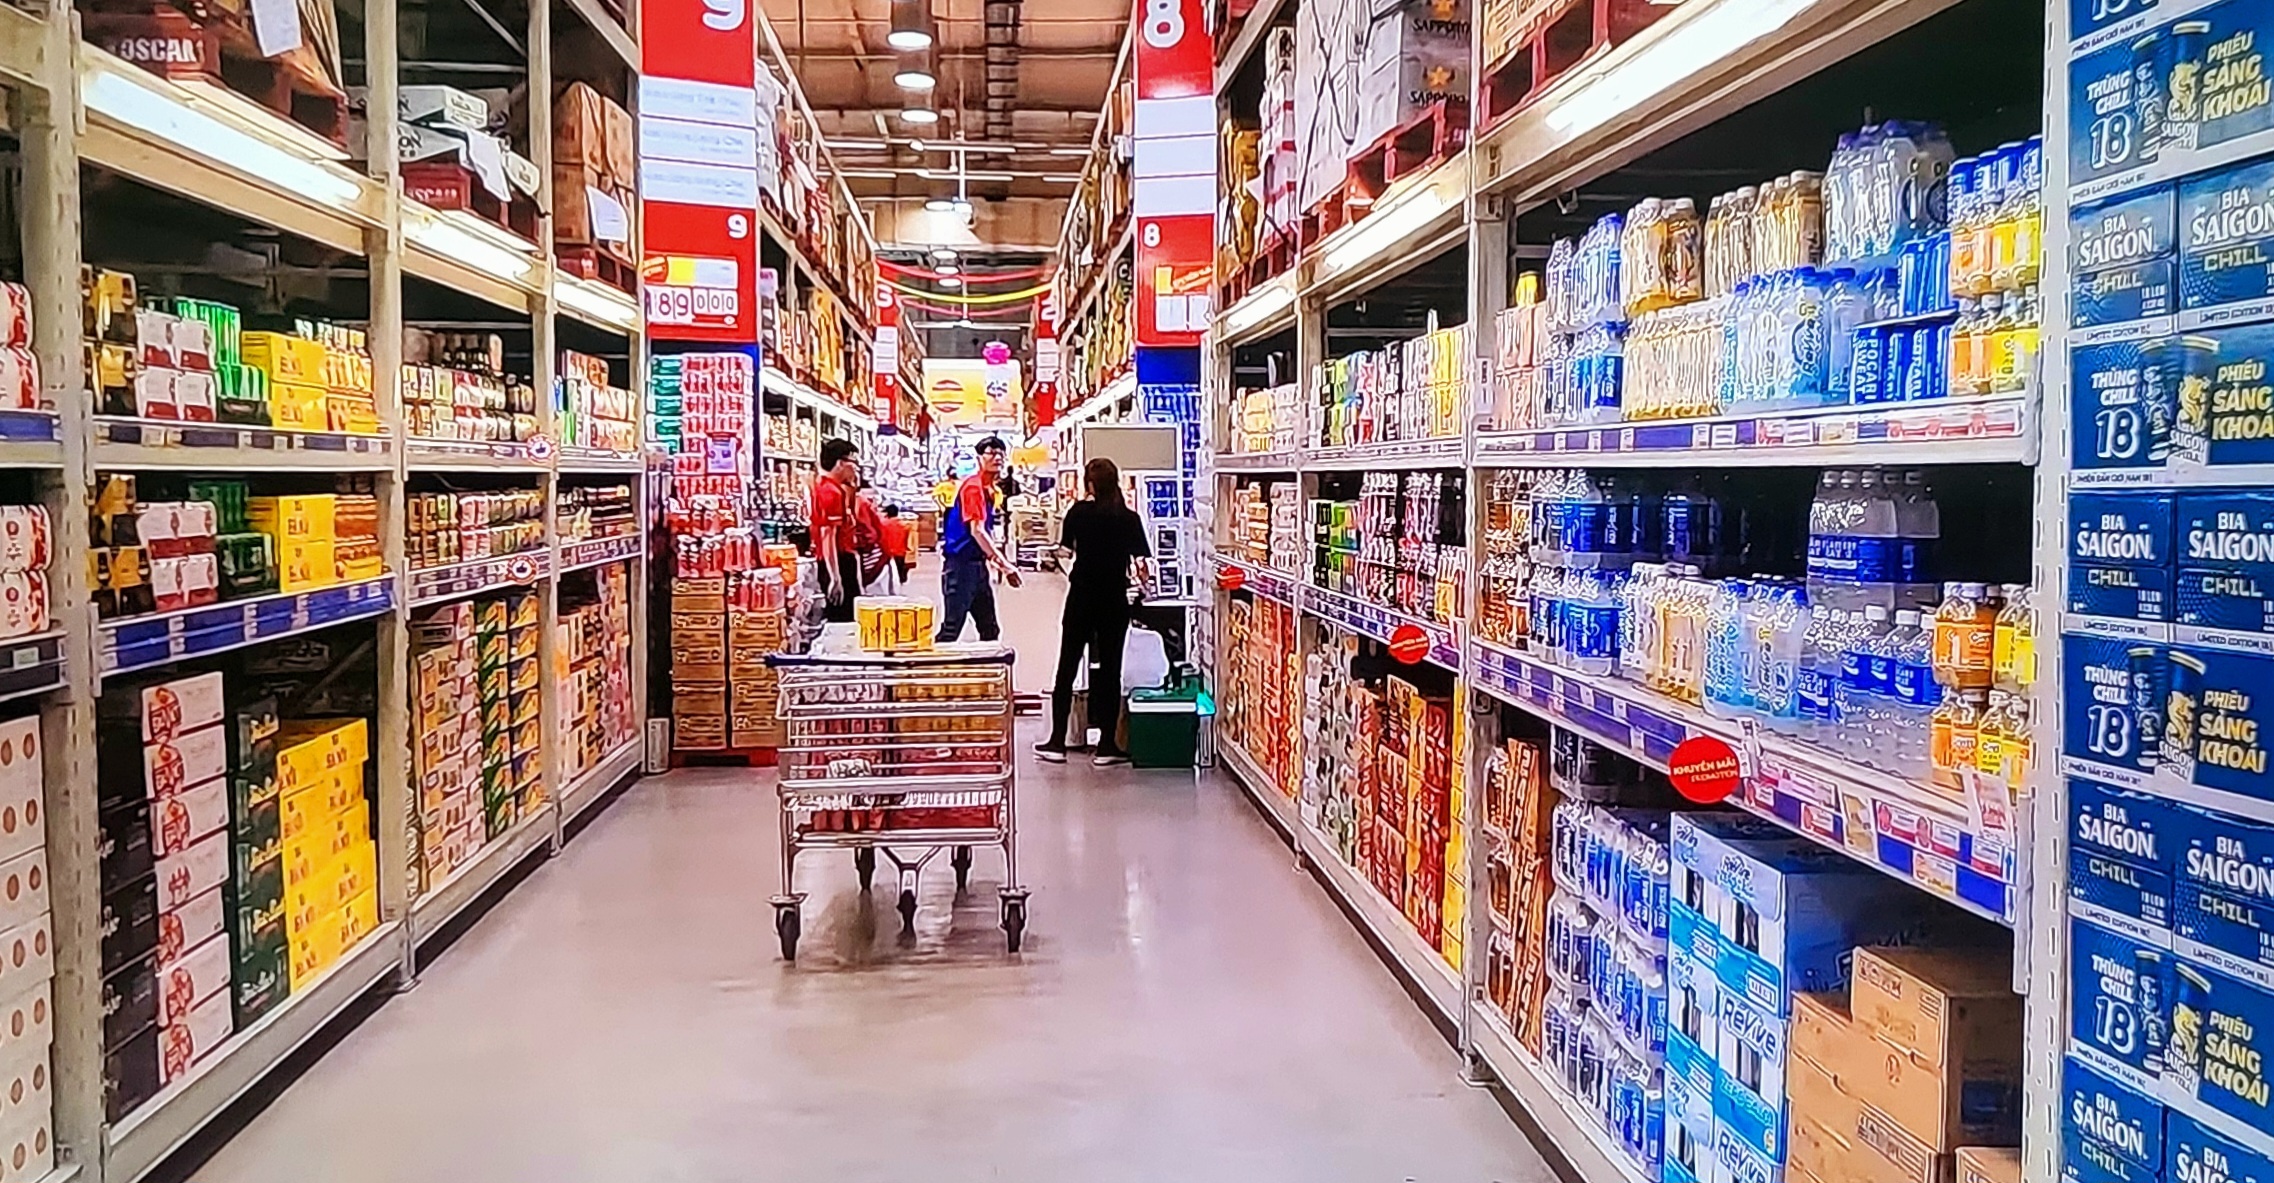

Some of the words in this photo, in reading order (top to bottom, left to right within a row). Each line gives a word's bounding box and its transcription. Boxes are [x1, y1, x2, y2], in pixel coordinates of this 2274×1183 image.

[1144, 0, 1184, 48] 8
[2095, 87, 2131, 115] CHILL
[2090, 113, 2131, 169] 18
[2220, 188, 2250, 211] BIA
[728, 213, 748, 239] 9
[1143, 222, 1161, 248] 8
[2102, 214, 2127, 234] BIA
[2191, 203, 2274, 246] SAIGON
[2079, 225, 2154, 267] SAIGON
[2204, 245, 2268, 271] CHILL
[2093, 272, 2143, 295] CHILL
[1864, 338, 1879, 400] POCARI
[2091, 366, 2138, 389] THÙNG
[2100, 385, 2138, 406] CHILL
[2095, 407, 2140, 459] 18
[2101, 514, 2125, 530] BIA
[2217, 512, 2245, 530] BIA
[2076, 530, 2153, 559] SAIGON
[2188, 530, 2274, 562] SAIGON
[2088, 569, 2139, 587] CHILL
[2201, 576, 2263, 597] CHILL
[2084, 664, 2128, 685] THÙNG
[2093, 685, 2129, 705] CHILL
[2088, 704, 2129, 757] 18
[2199, 709, 2258, 742] SẢNG
[2199, 739, 2267, 773] KHOÁI
[2103, 803, 2128, 824] BIA
[2078, 814, 2157, 860] SAIGON
[2216, 836, 2244, 859] BIA
[2089, 858, 2141, 888] CHILL
[2186, 848, 2274, 899] SAIGON
[2199, 893, 2261, 928] CHILL
[2091, 954, 2136, 985] THÙNG
[2100, 977, 2136, 1004] CHILL
[2095, 995, 2136, 1054] 18
[2204, 1032, 2261, 1074] SẢNG
[2204, 1058, 2270, 1108] KHOÁI
[2096, 1092, 2118, 1120] BIA
[2072, 1098, 2149, 1160] SAIGON
[2081, 1140, 2131, 1181] CHILL
[2203, 1147, 2229, 1175] BIA
